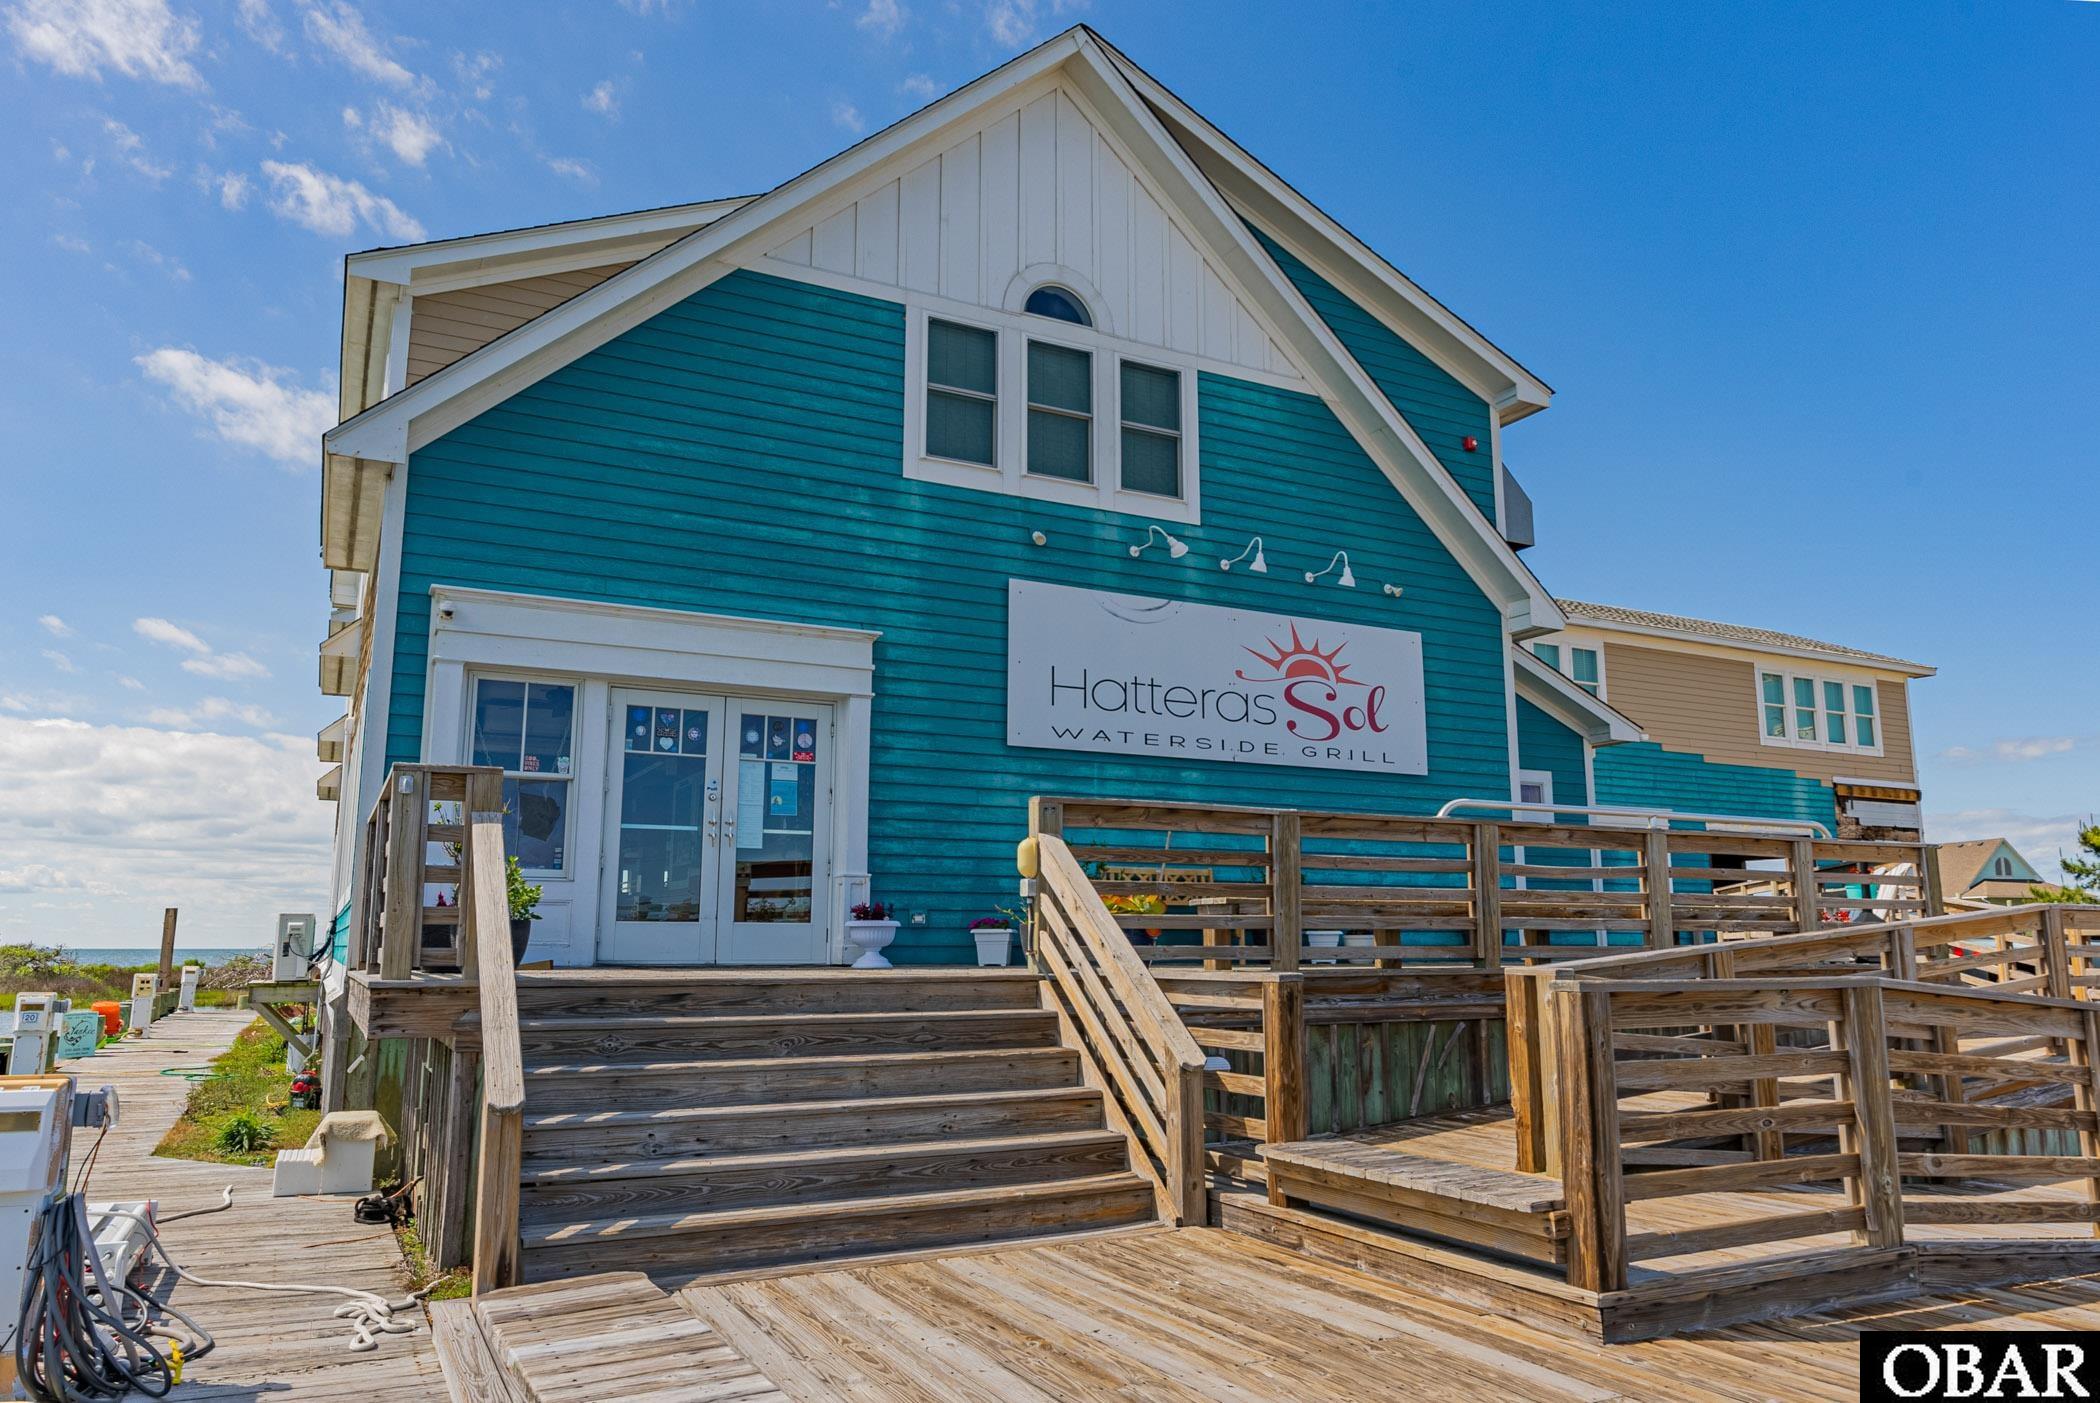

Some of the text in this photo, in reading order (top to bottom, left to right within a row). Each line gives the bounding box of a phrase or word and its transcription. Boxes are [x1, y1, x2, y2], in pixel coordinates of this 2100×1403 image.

[1051, 665, 1389, 742] Hatteras Sol
[1051, 725, 1395, 764] WATERSIDE GRILL
